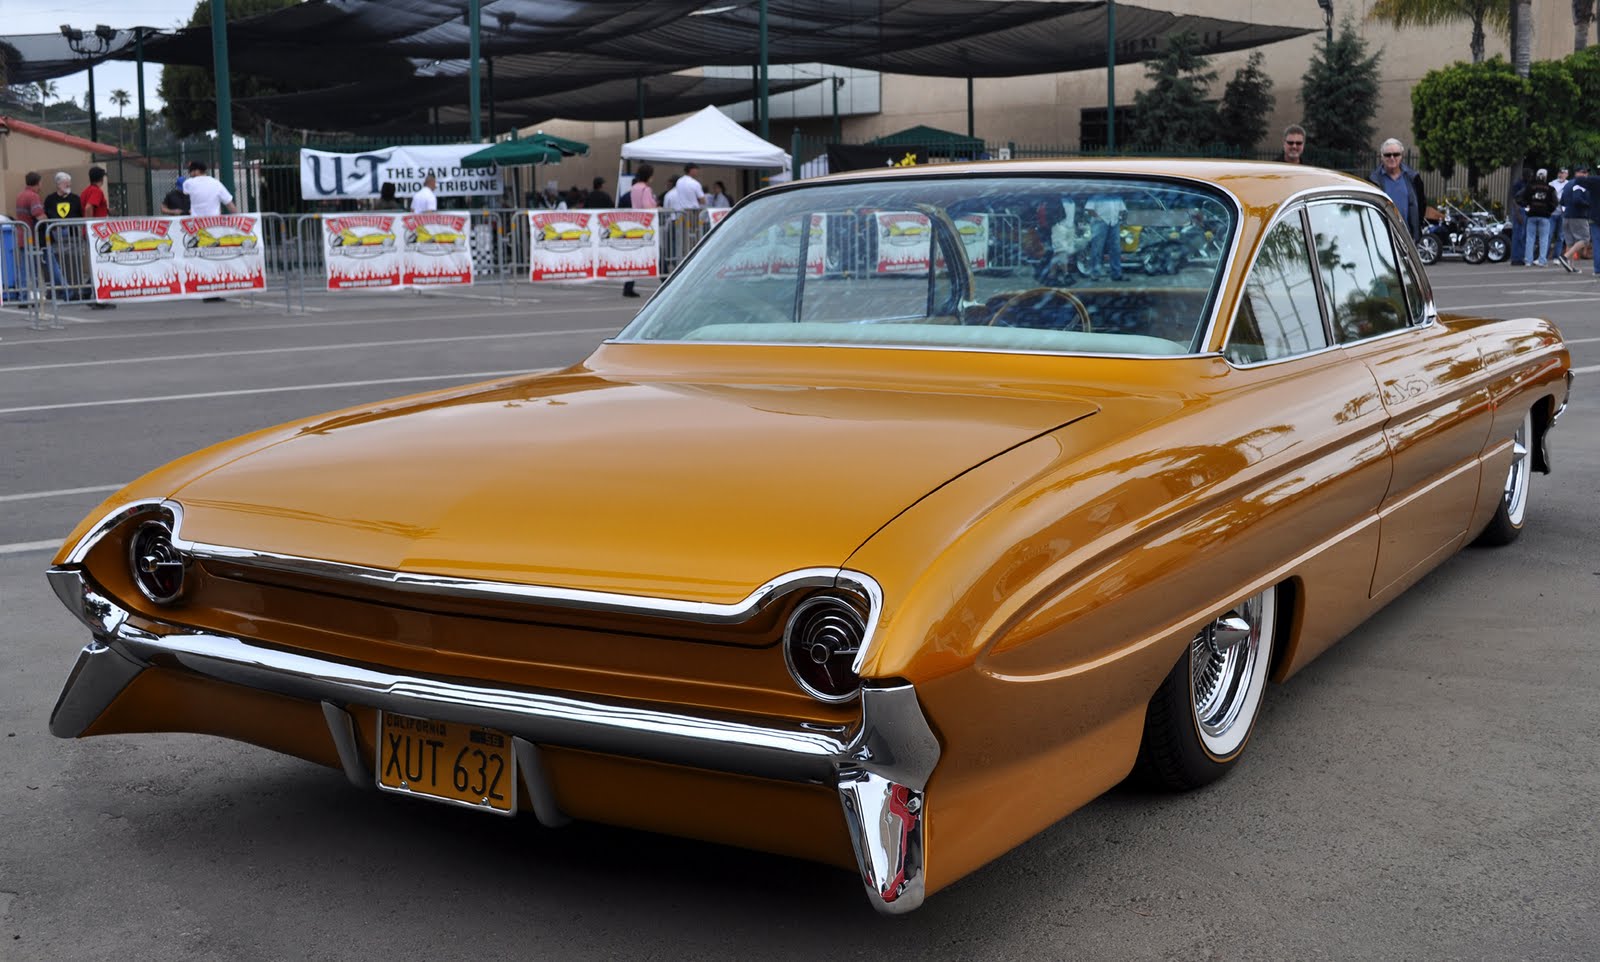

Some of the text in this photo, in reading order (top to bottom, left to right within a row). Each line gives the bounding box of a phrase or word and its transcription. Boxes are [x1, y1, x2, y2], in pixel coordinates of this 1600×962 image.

[386, 166, 497, 179] THE SAN DIEGO
[386, 714, 446, 736] CALIFORNIA
[386, 733, 504, 800] XUT 632
